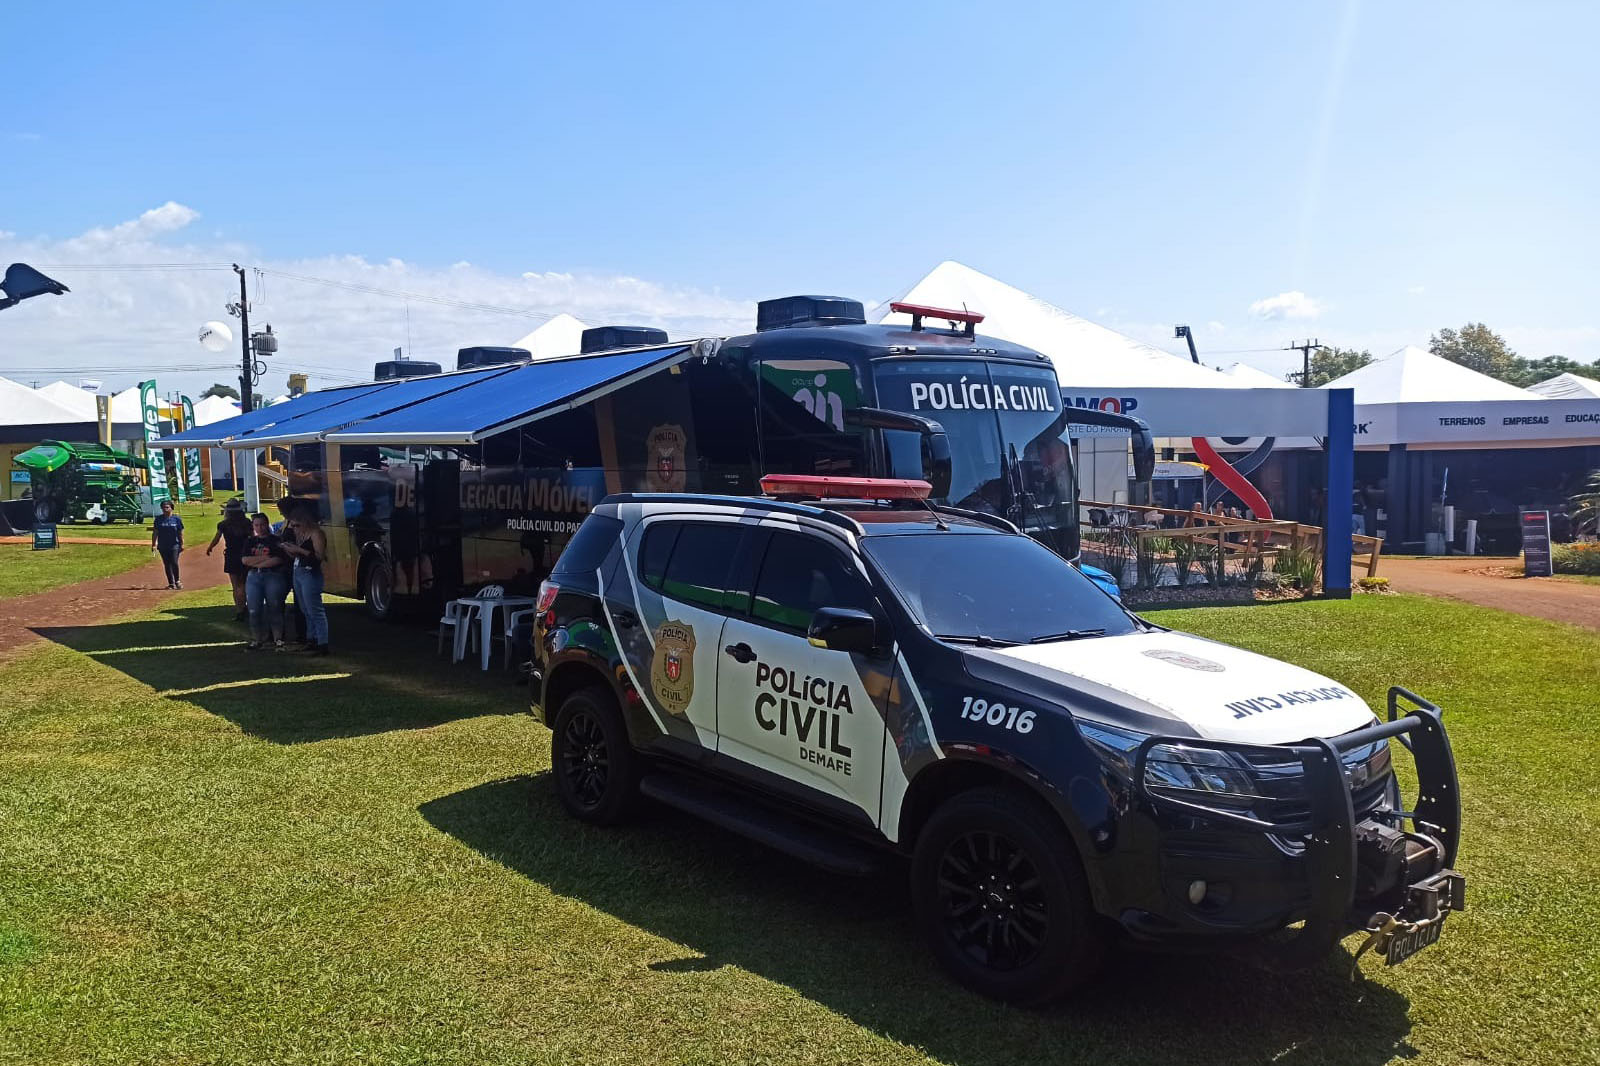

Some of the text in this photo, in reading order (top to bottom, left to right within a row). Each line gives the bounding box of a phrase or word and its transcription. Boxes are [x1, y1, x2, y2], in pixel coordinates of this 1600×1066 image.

[910, 375, 1055, 412] POLÍCIA CIVIL
[1087, 425, 1098, 433] DO
[1439, 416, 1486, 426] TERRENOS
[1503, 416, 1550, 426] EMPRESAS
[507, 516, 534, 531] POLÍCIA
[535, 519, 553, 532] CIVIL
[554, 521, 565, 533] DO
[662, 627, 688, 642] POLÍCIA
[661, 688, 683, 701] CIVIL
[756, 662, 854, 714] POLÍCIA
[960, 696, 1037, 734] 19016
[755, 692, 852, 758] CIVIL
[800, 746, 852, 776] DEMAFE
